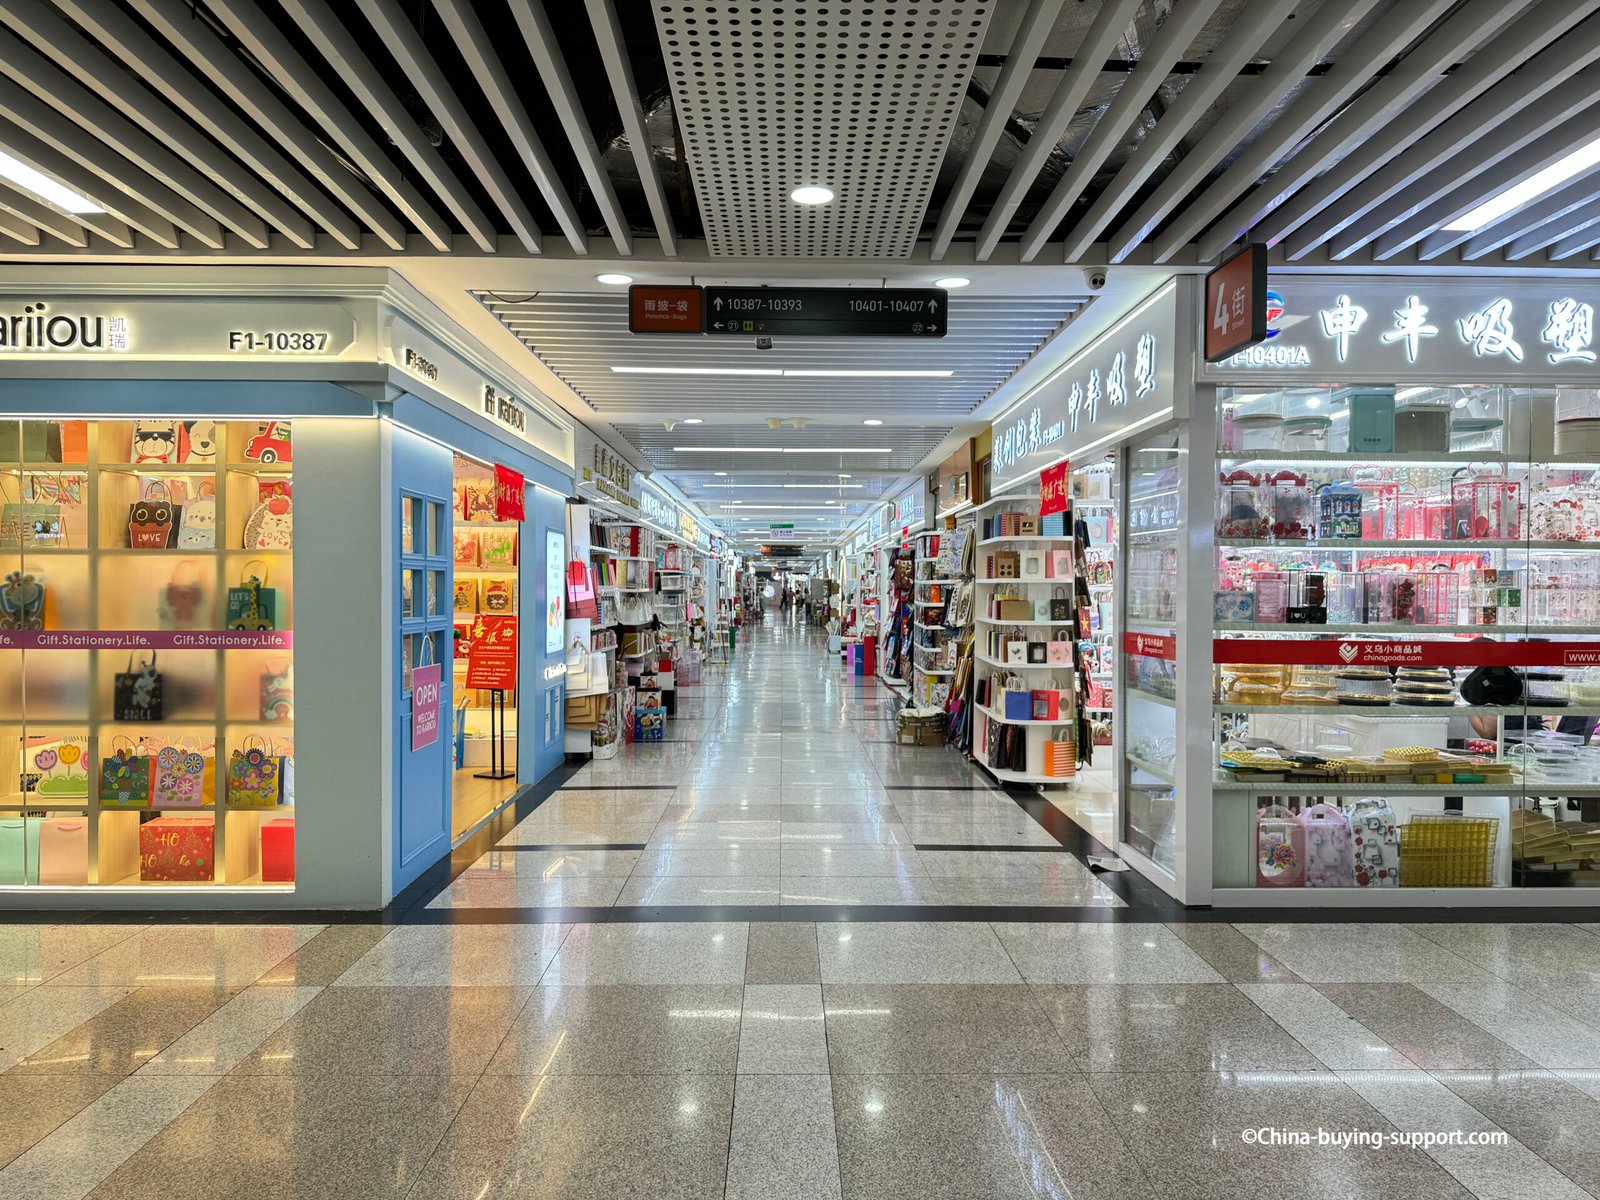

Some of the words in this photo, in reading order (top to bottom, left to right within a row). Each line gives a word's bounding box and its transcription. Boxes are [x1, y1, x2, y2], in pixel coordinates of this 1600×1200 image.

[728, 299, 802, 311] 10387-10393
[849, 300, 924, 312] 10401-10407
[1320, 294, 1597, 363] 申丰吸塑
[229, 331, 328, 350] F1-10387
[1216, 346, 1310, 366] 1-10401A
[37, 634, 151, 646] Gift.Stationery.Life.
[173, 634, 286, 647] Gift.Stationery.Life.
[1364, 644, 1422, 654] 义乌小商品城
[1363, 654, 1423, 662] chinagoods.com
[416, 681, 438, 706] OPEN
[417, 709, 436, 724] WELCOME
[160, 832, 179, 847] HO
